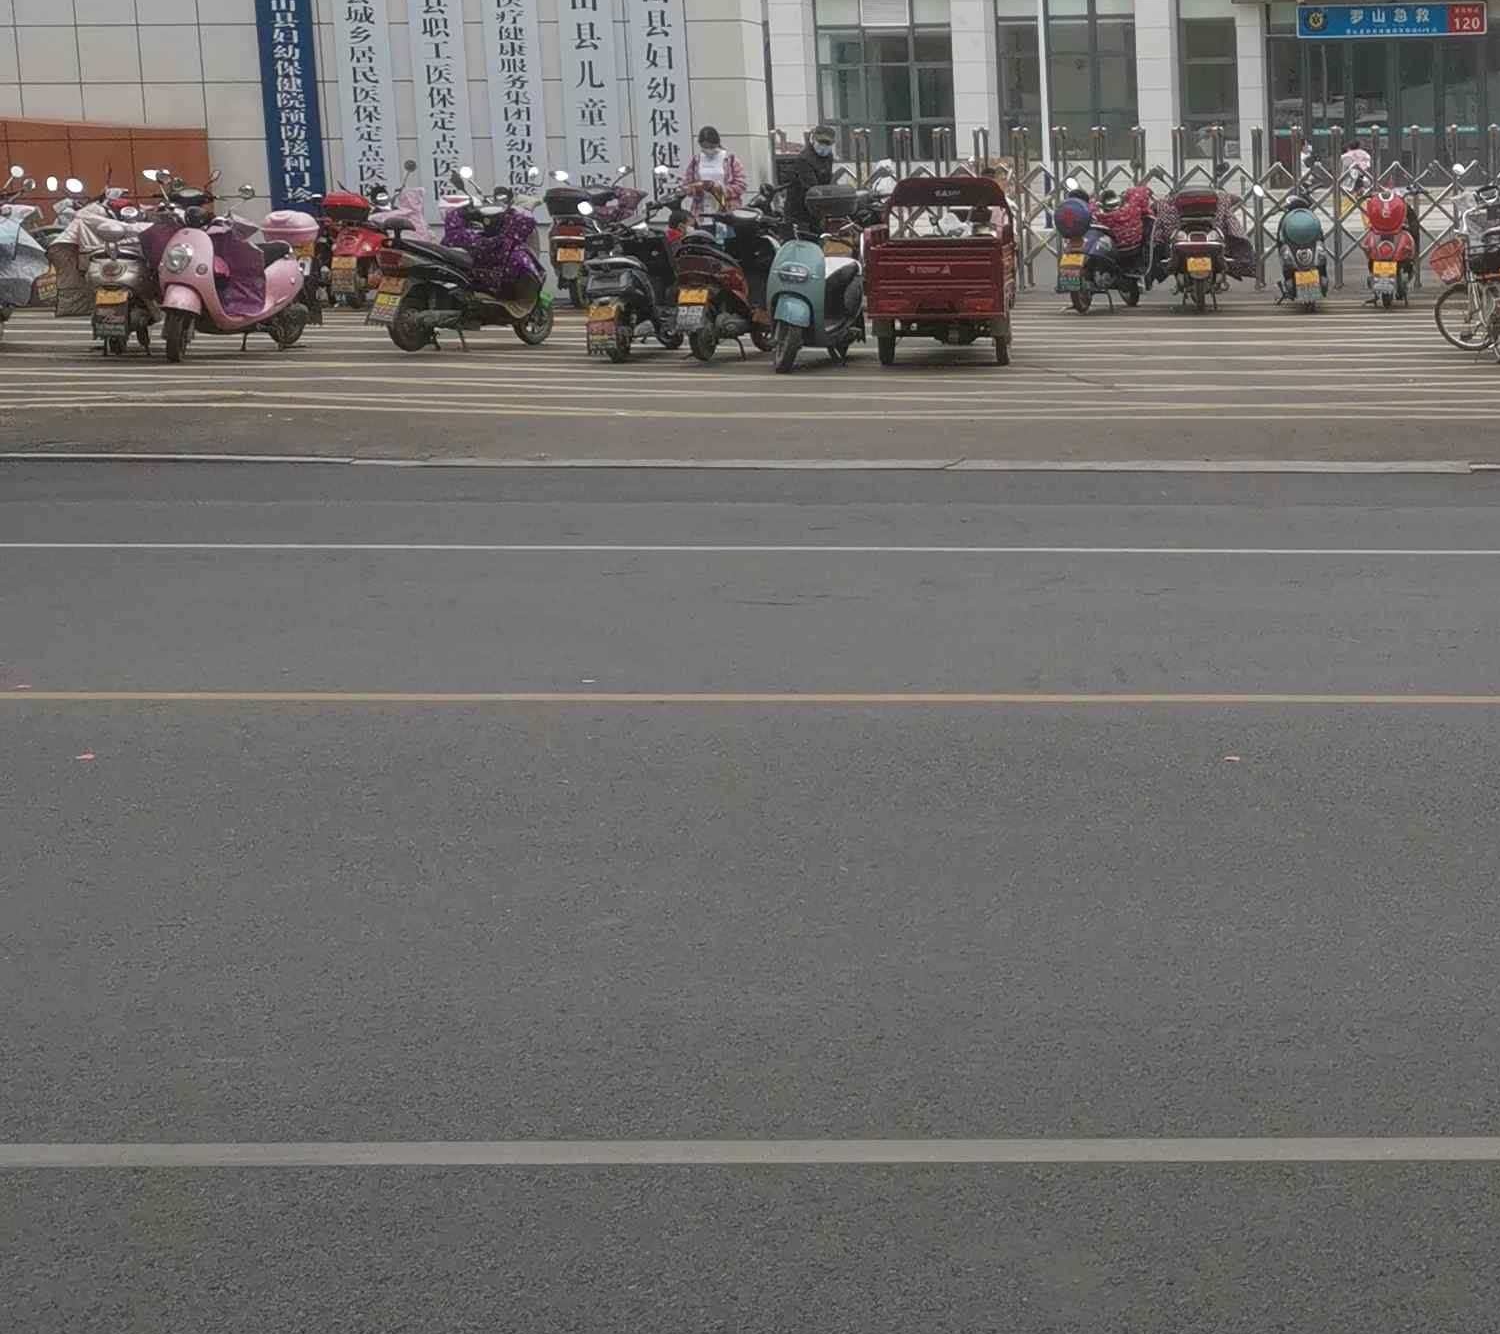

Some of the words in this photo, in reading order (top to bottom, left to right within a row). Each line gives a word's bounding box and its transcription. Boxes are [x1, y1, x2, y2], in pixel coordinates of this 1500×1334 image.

[1350, 7, 1430, 24] 罗山急救
[1454, 17, 1480, 30] 120
